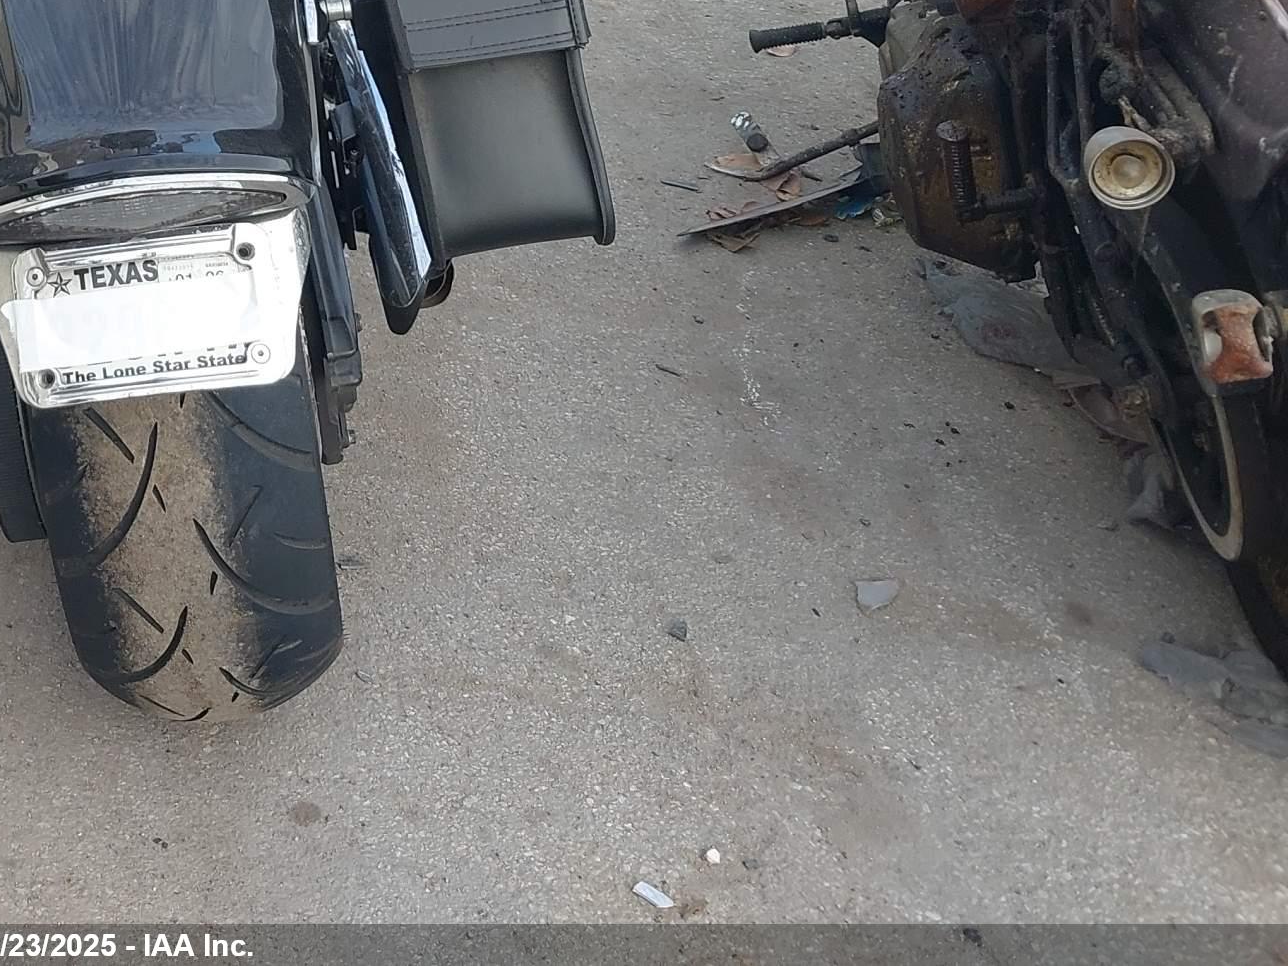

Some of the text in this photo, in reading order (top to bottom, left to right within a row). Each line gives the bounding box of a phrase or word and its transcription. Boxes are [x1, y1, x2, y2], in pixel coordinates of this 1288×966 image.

[73, 259, 159, 291] TEXAS
[62, 352, 247, 385] The Lone Star State
